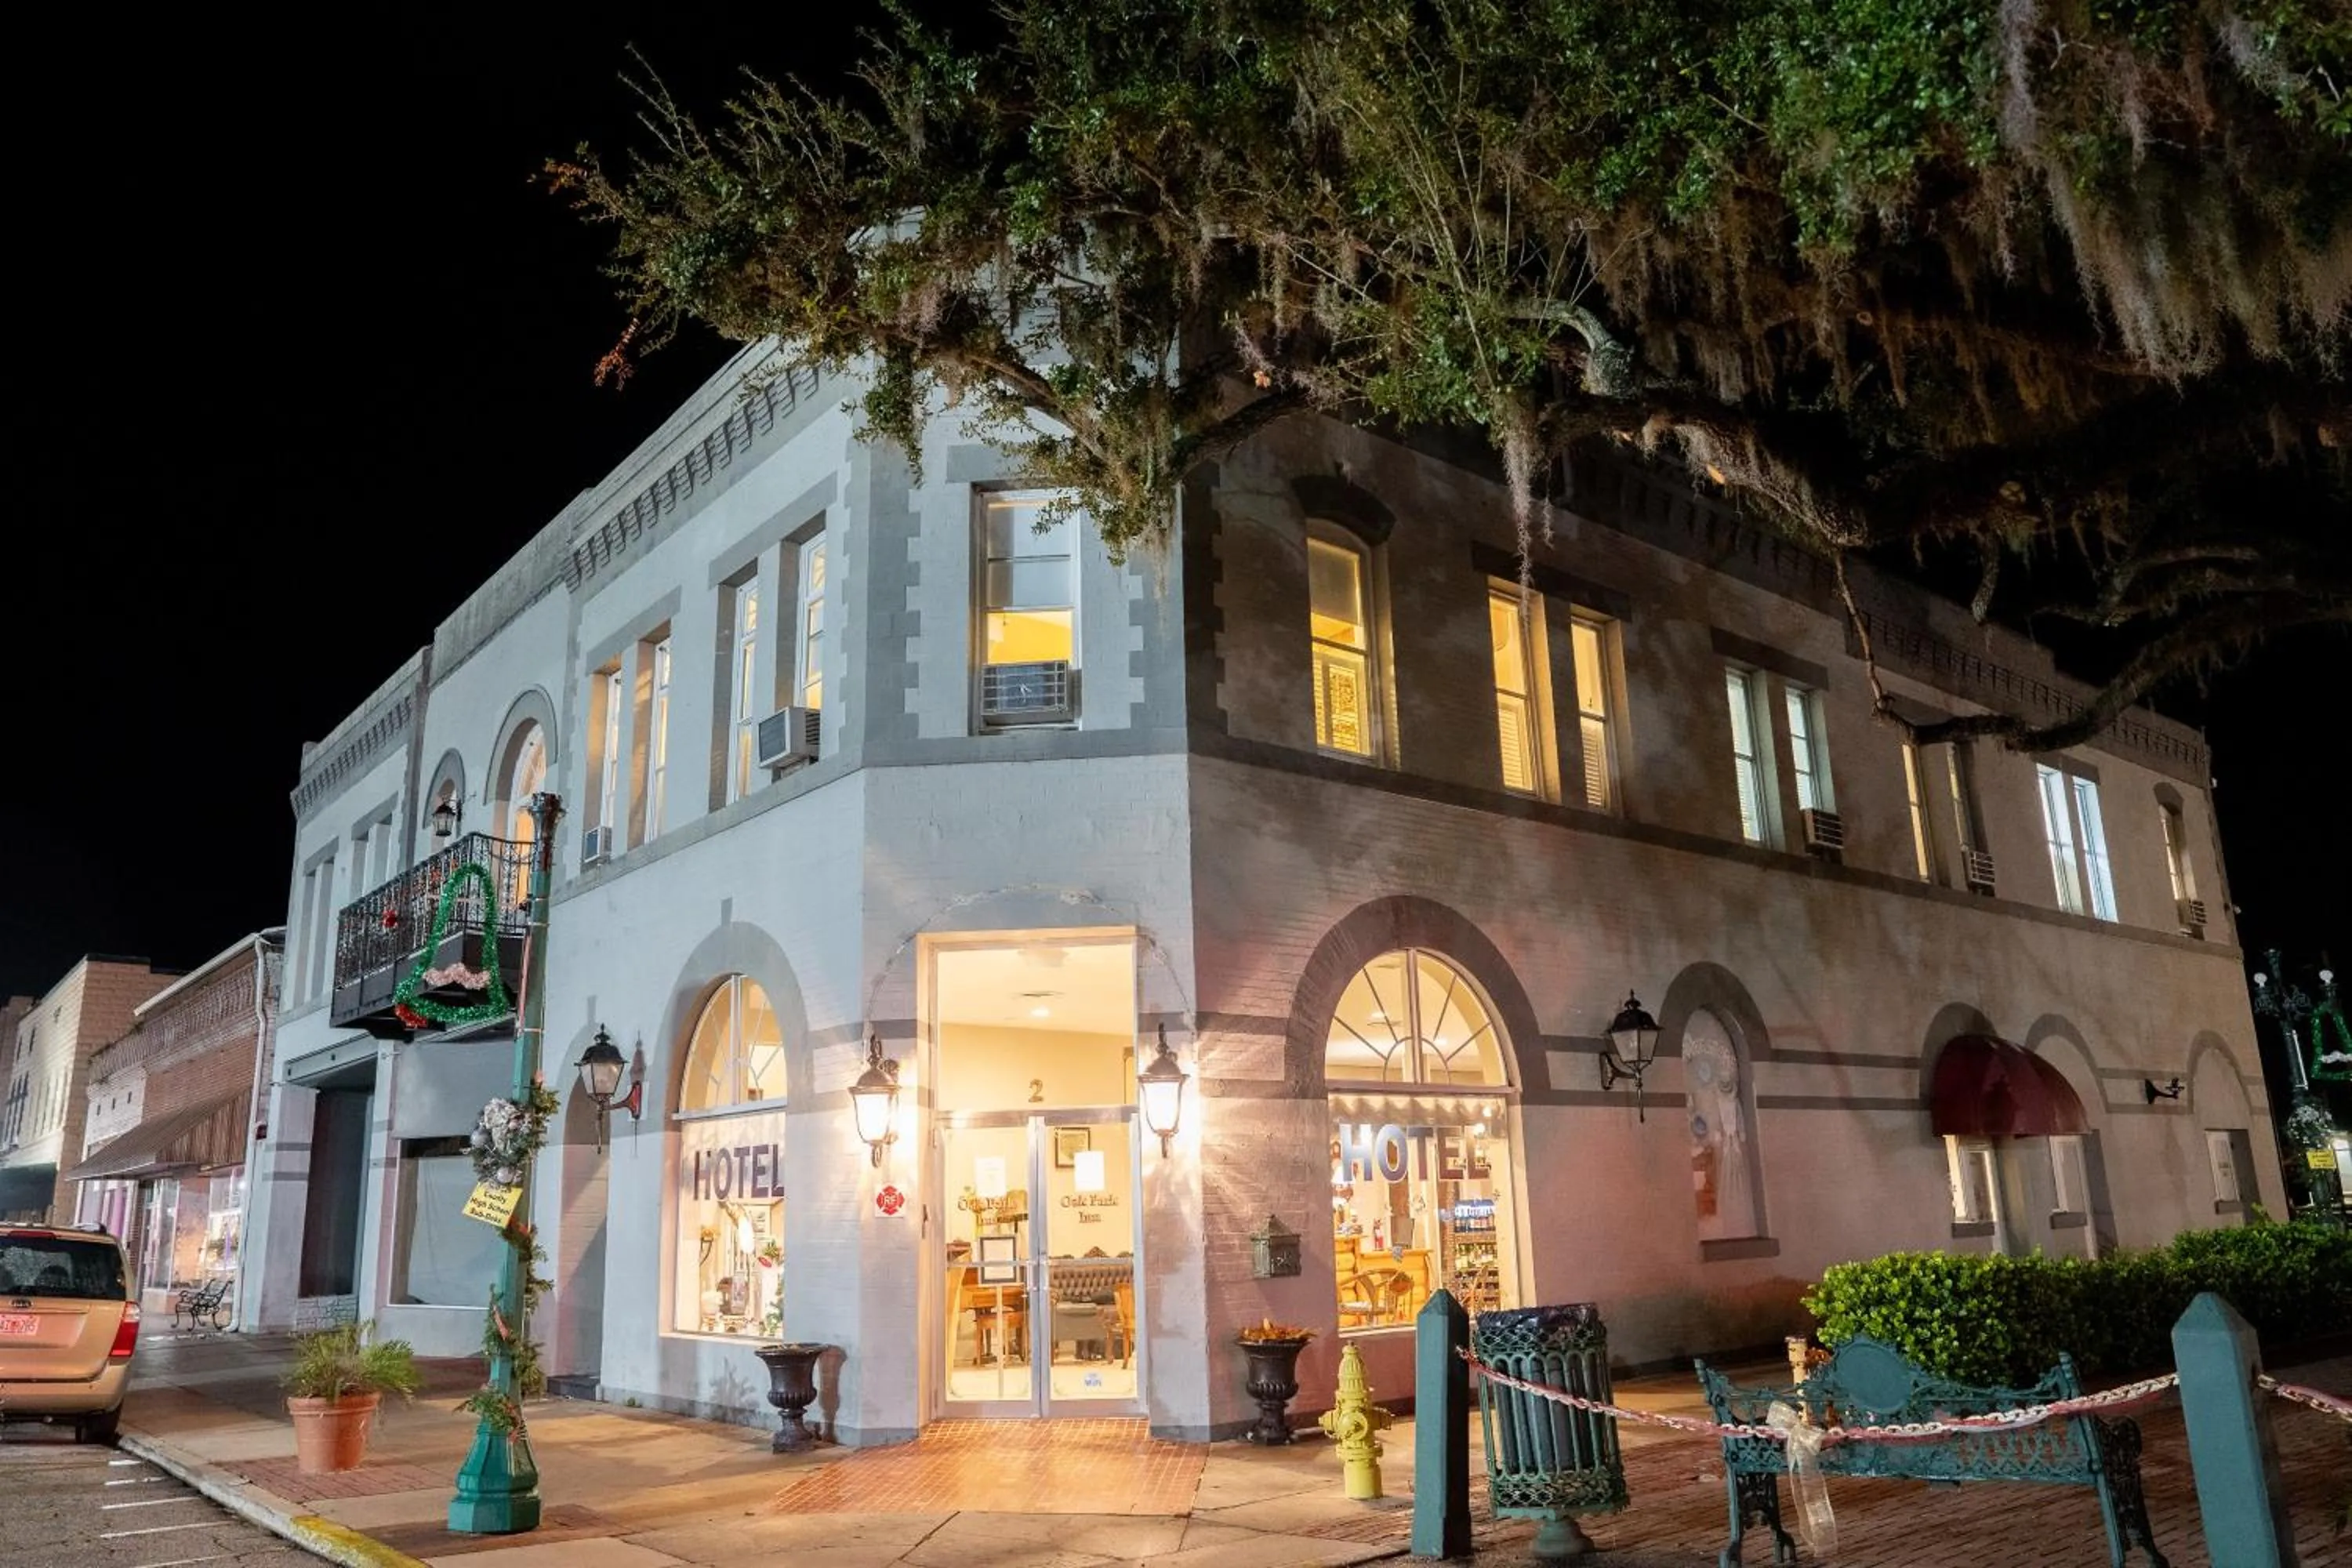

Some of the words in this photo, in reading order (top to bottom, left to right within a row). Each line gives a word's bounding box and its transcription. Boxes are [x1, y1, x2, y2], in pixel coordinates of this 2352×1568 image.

[1029, 1079, 1044, 1102] 2
[1339, 1124, 1490, 1181] HOTEL
[694, 1144, 784, 1200] HOTEL
[1061, 1195, 1087, 1208] Oak
[1089, 1194, 1118, 1207] Park
[1079, 1211, 1102, 1224] Inn
